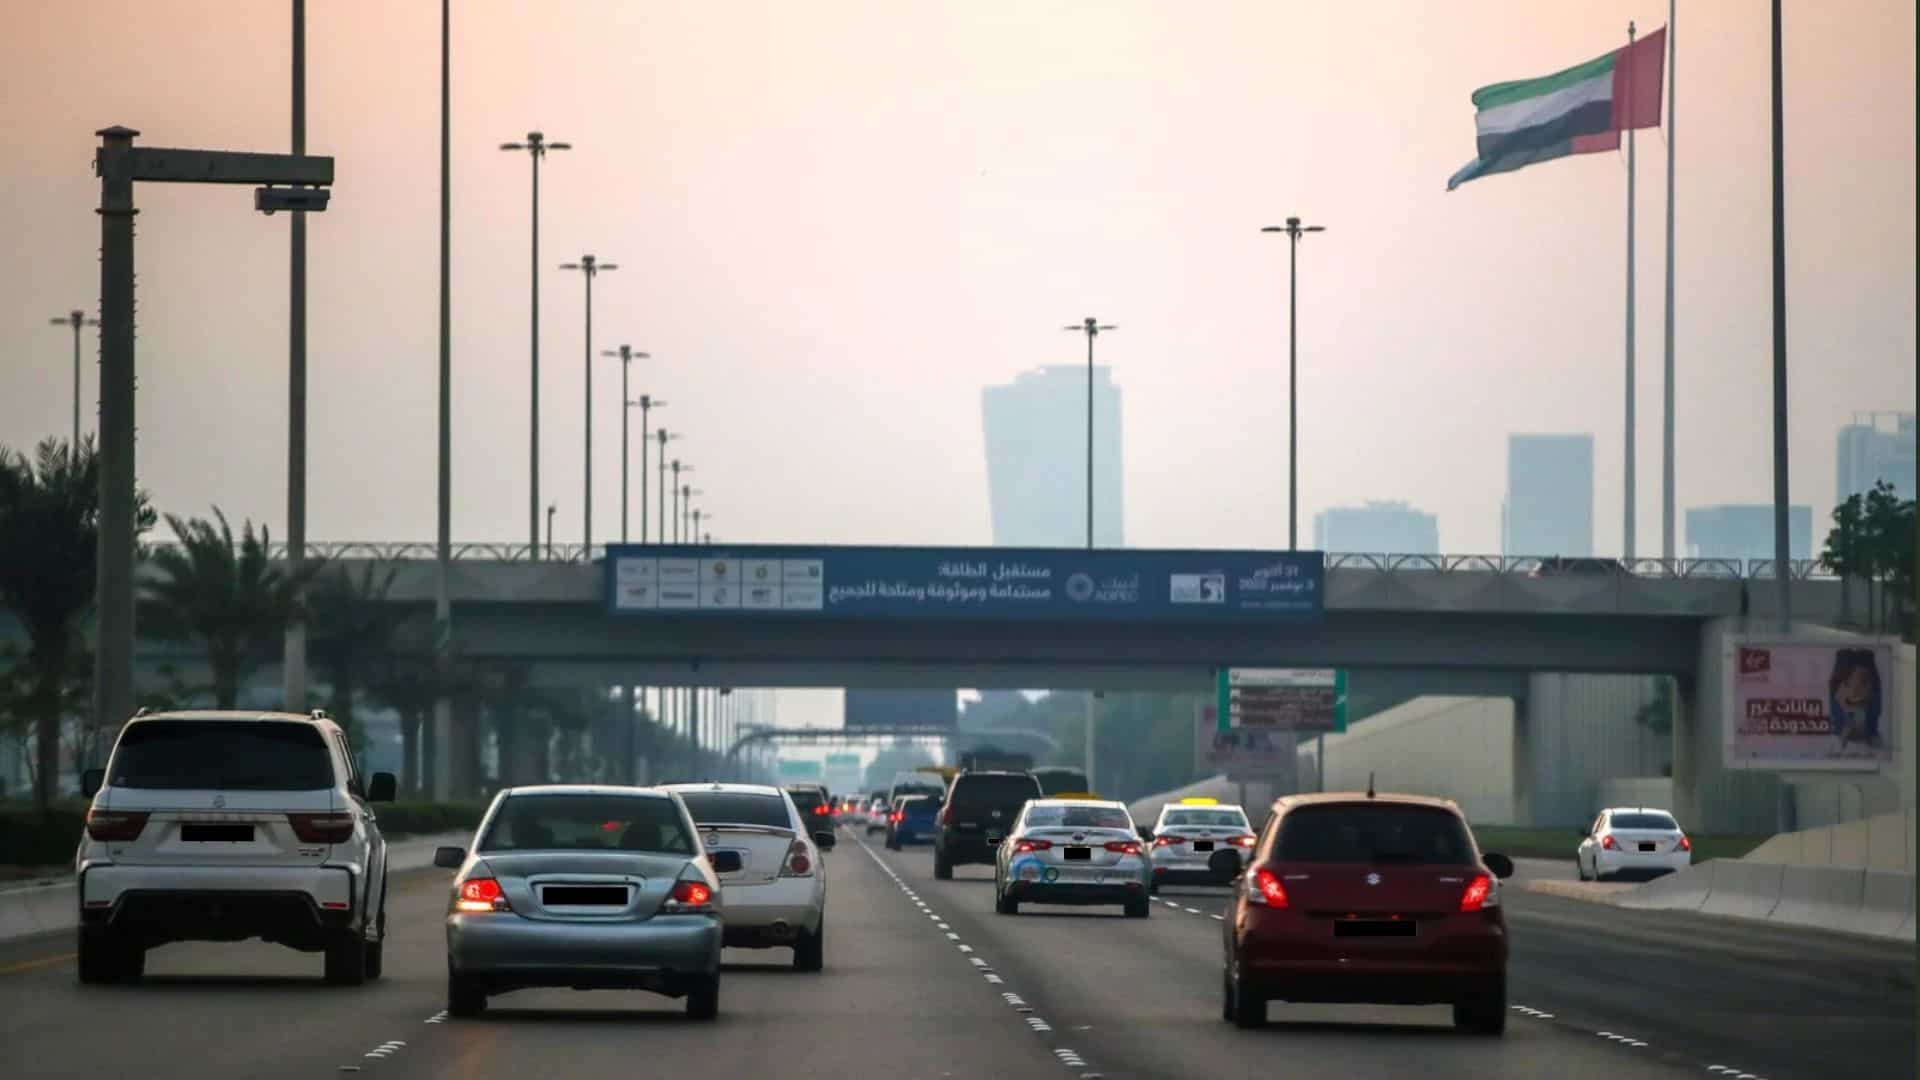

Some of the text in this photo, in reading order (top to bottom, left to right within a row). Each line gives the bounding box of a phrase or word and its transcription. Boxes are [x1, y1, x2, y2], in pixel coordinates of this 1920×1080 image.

[992, 562, 1050, 581] مستقبل
[829, 579, 876, 603] للجميع
[927, 581, 987, 601] وموثوقة
[989, 581, 1050, 599] مستدامة
[1751, 700, 1821, 717] بيانات غير
[1769, 716, 1830, 733] محدودة
